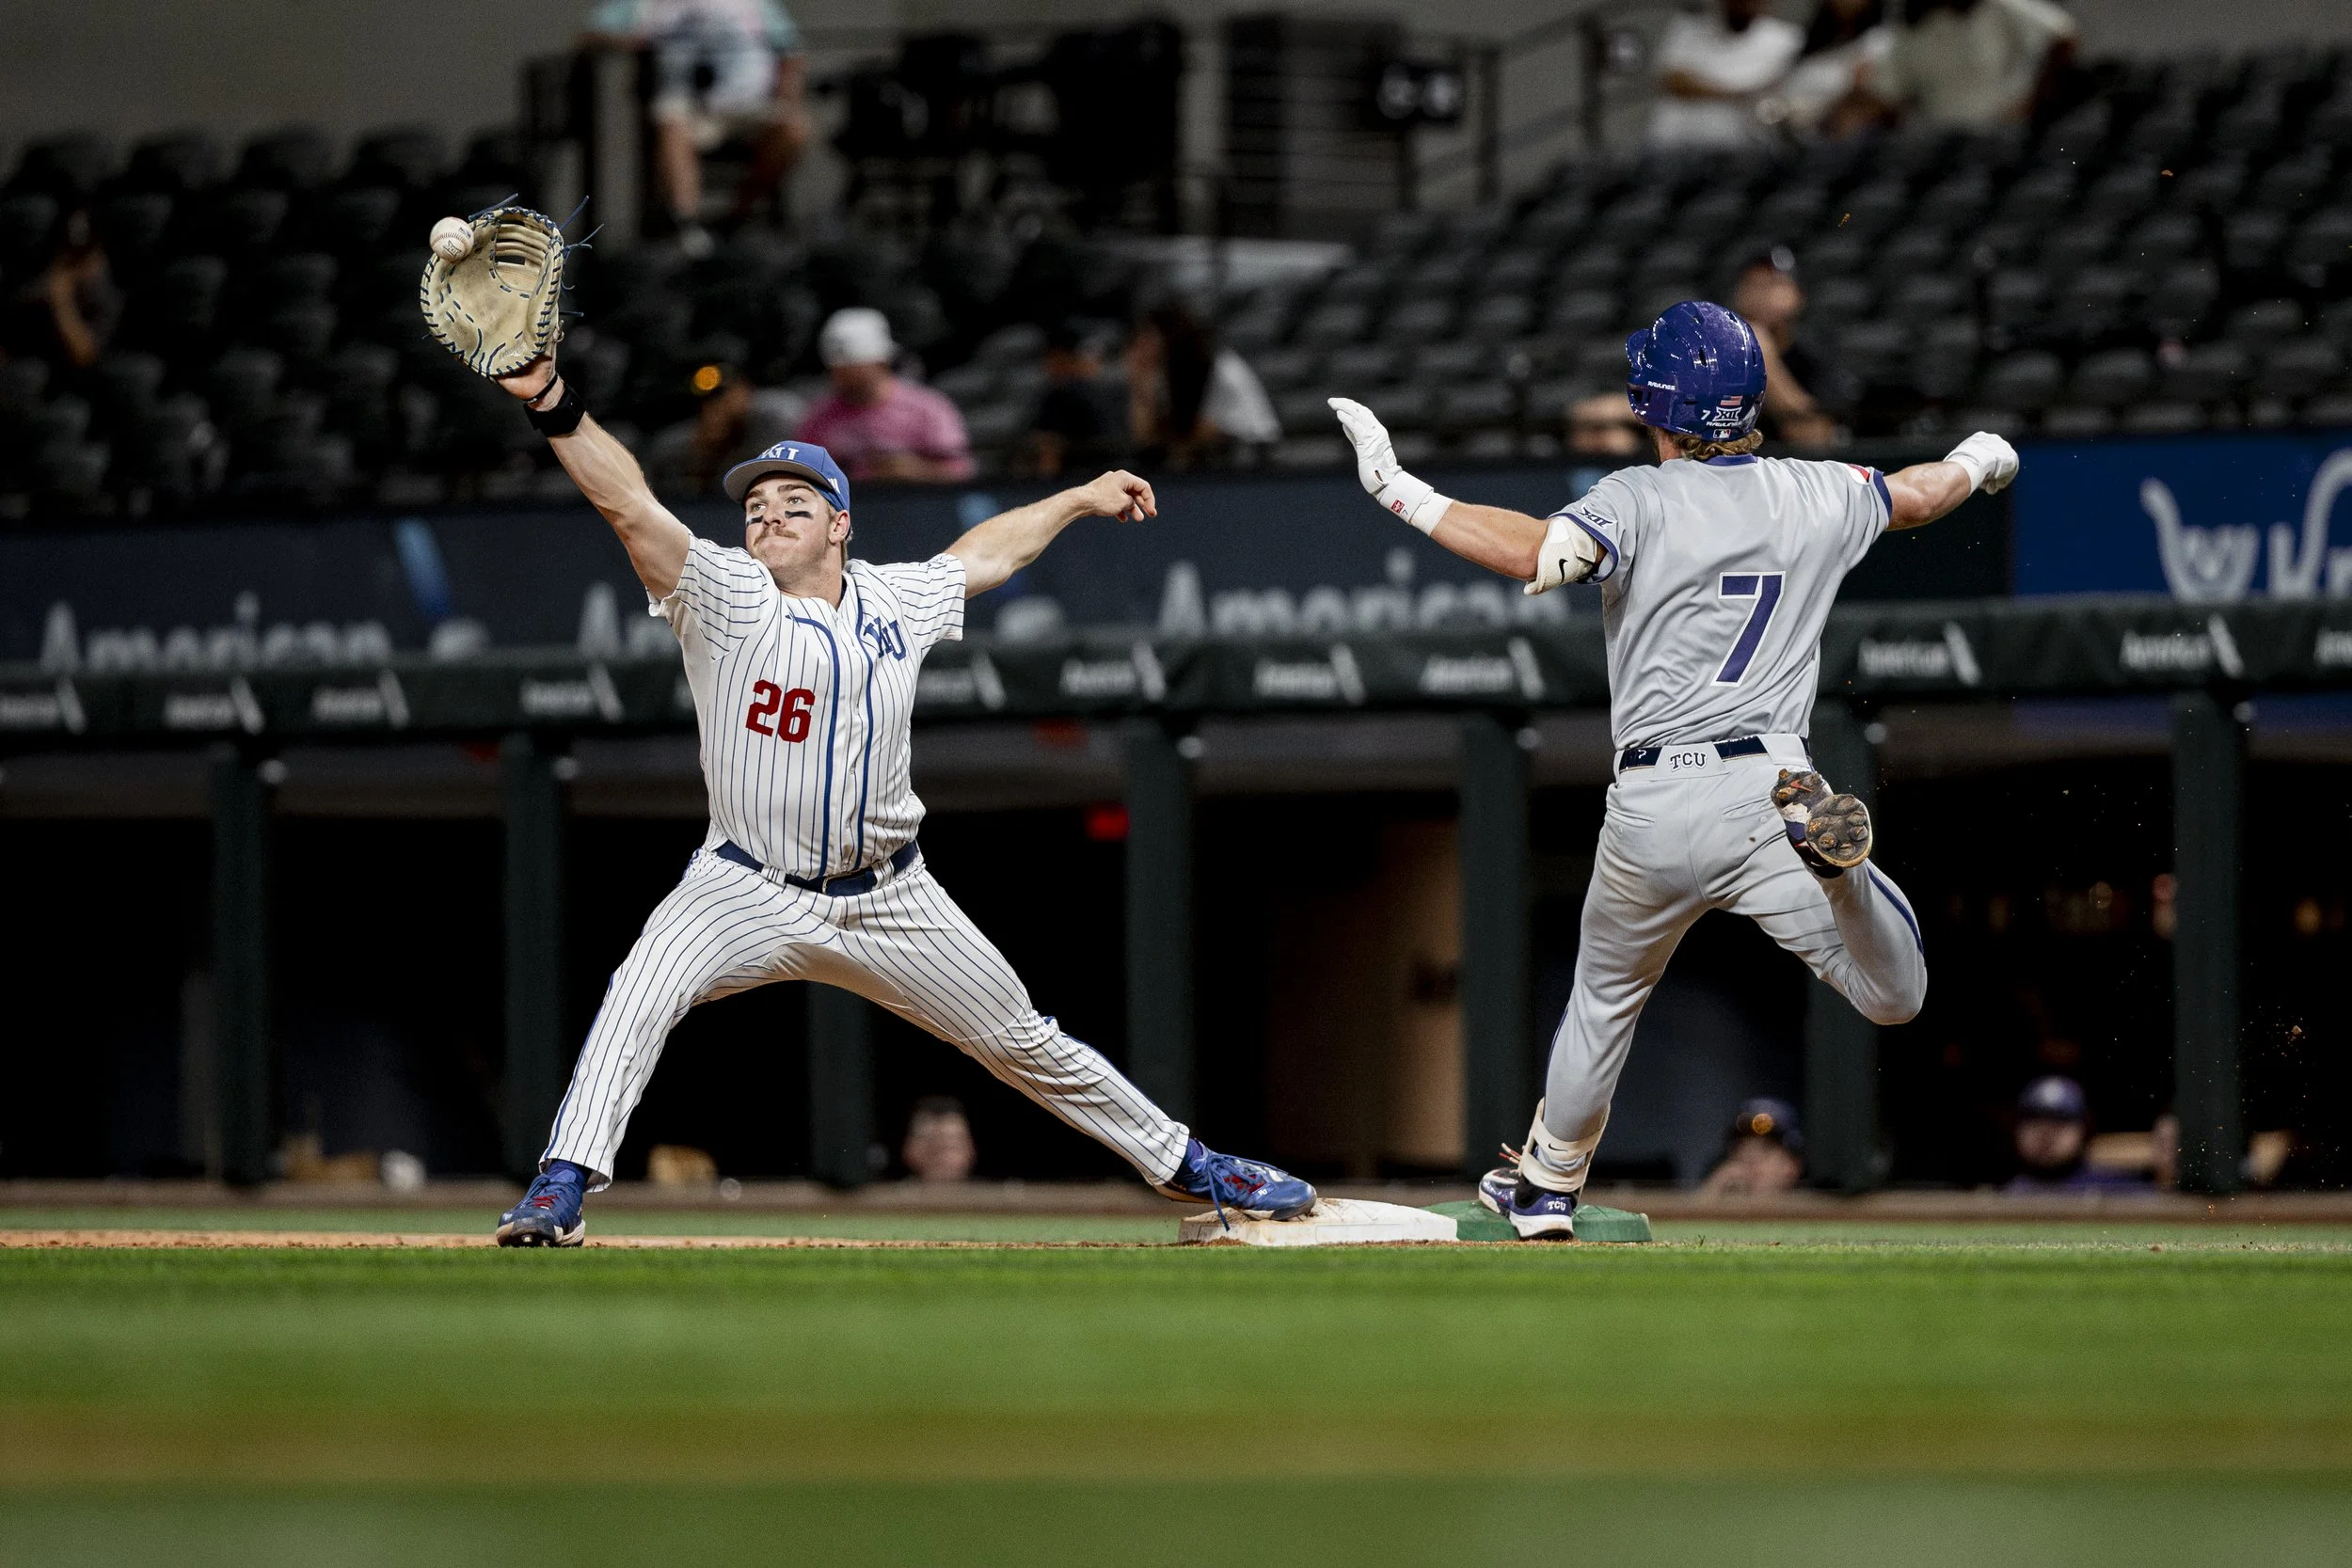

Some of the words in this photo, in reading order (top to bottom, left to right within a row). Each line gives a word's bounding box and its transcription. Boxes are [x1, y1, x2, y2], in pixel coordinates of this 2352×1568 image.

[1701, 409, 1710, 420] 7
[1709, 571, 1786, 688] 7
[745, 679, 816, 743] 26
[1670, 752, 1707, 770] TCU
[1547, 1200, 1566, 1212] TCU
